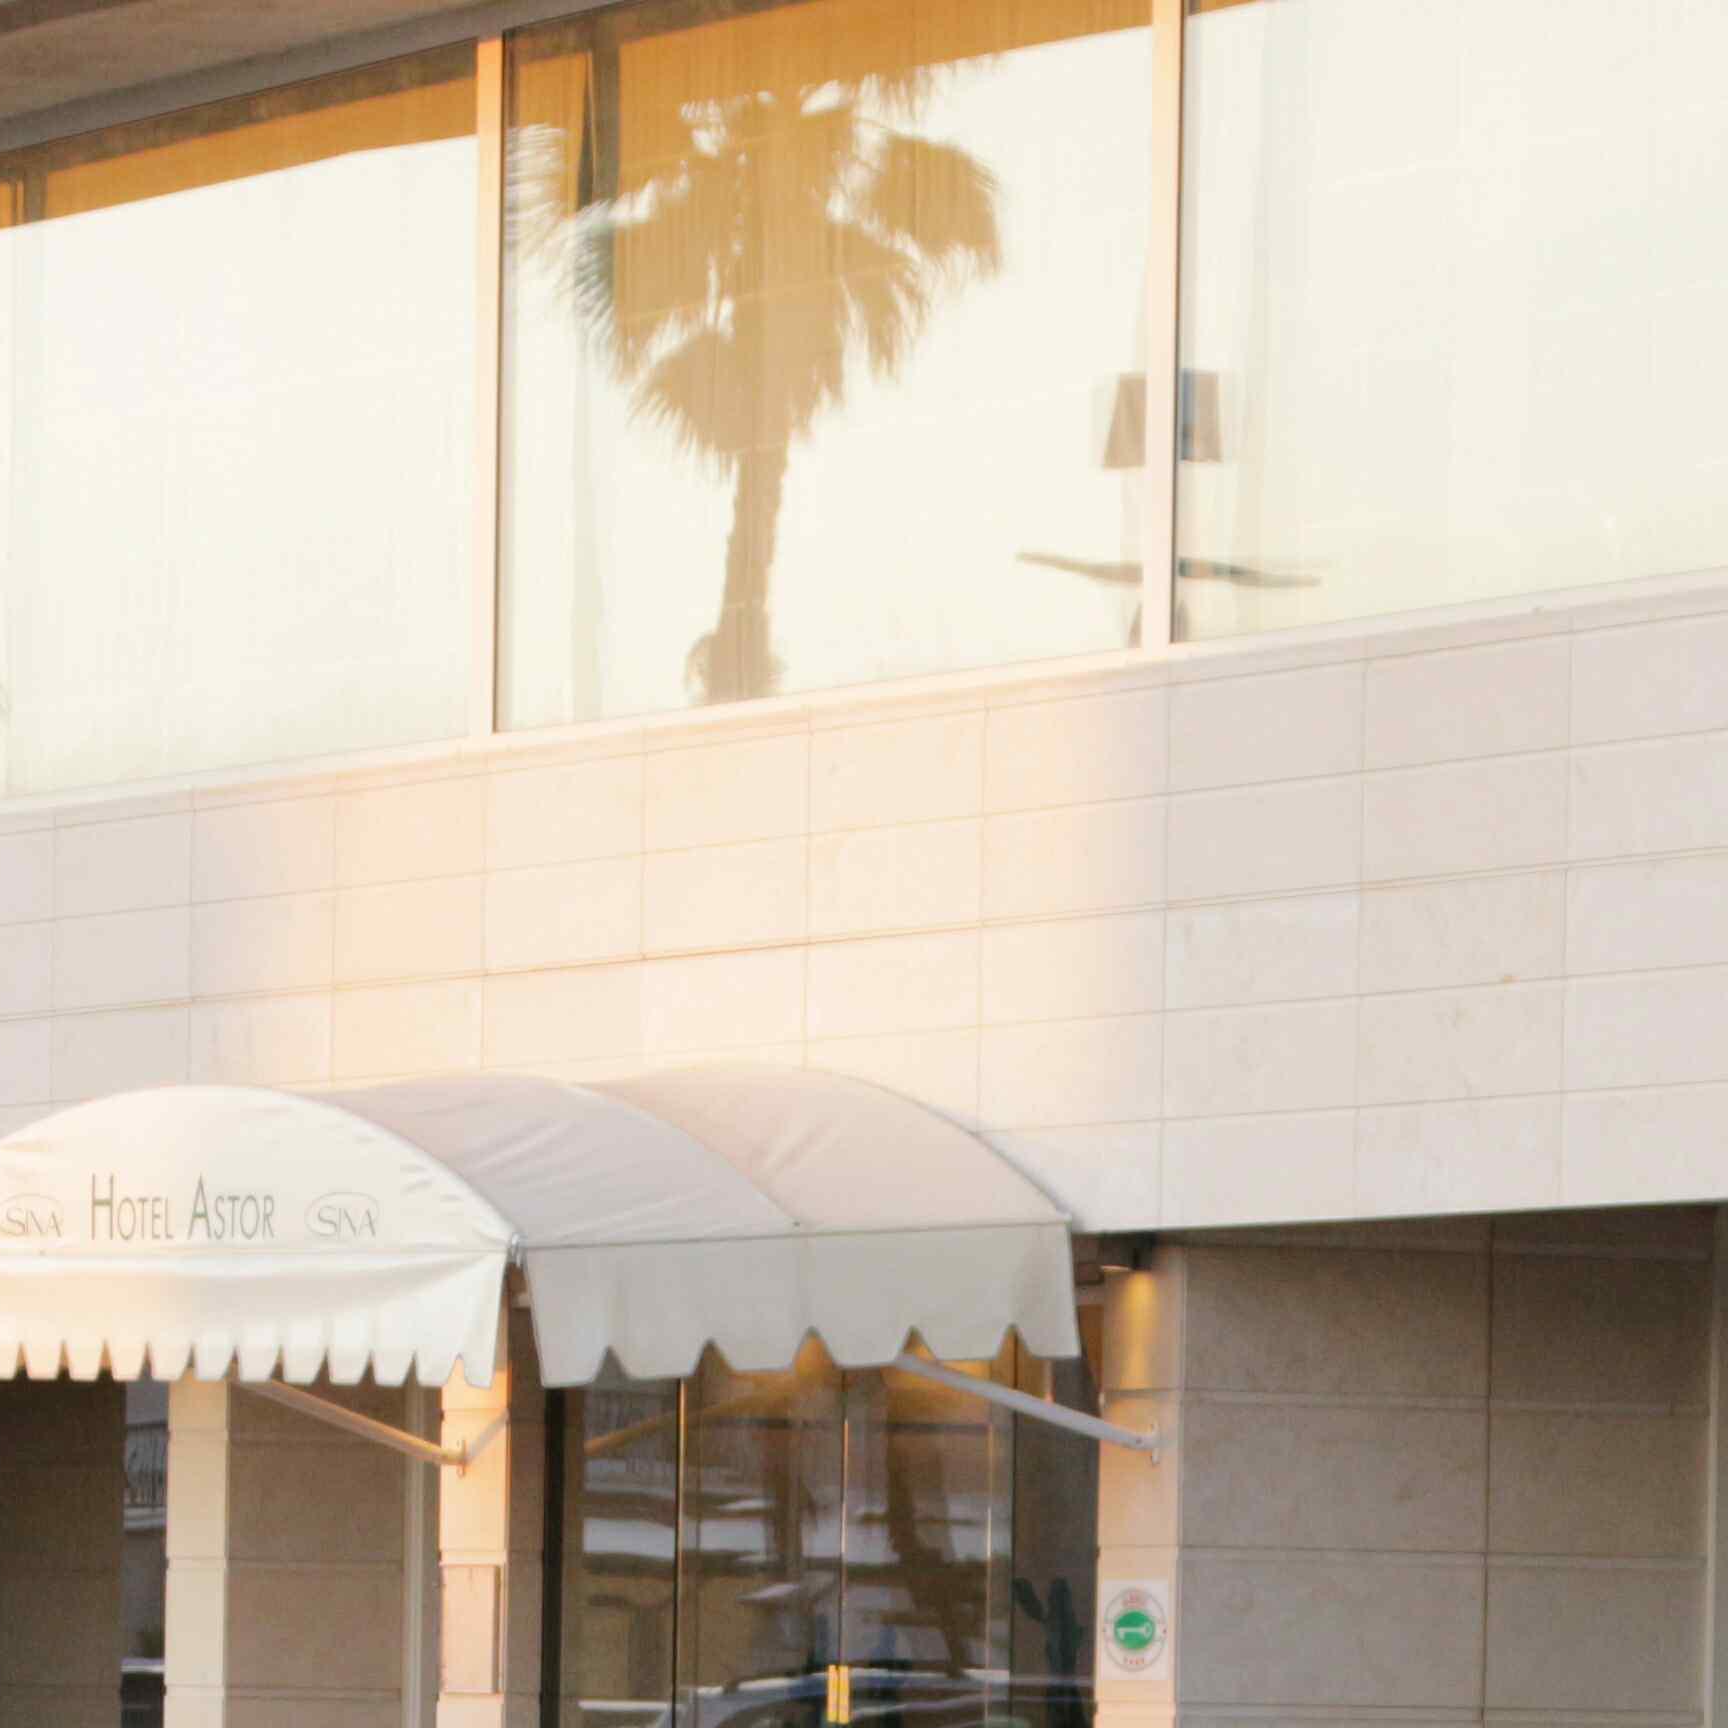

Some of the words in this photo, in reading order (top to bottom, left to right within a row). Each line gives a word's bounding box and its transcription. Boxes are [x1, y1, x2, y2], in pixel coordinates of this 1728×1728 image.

[91, 1173, 174, 1240] HOTEL
[187, 1171, 276, 1240] ASTOR
[317, 1205, 377, 1238] SINA
